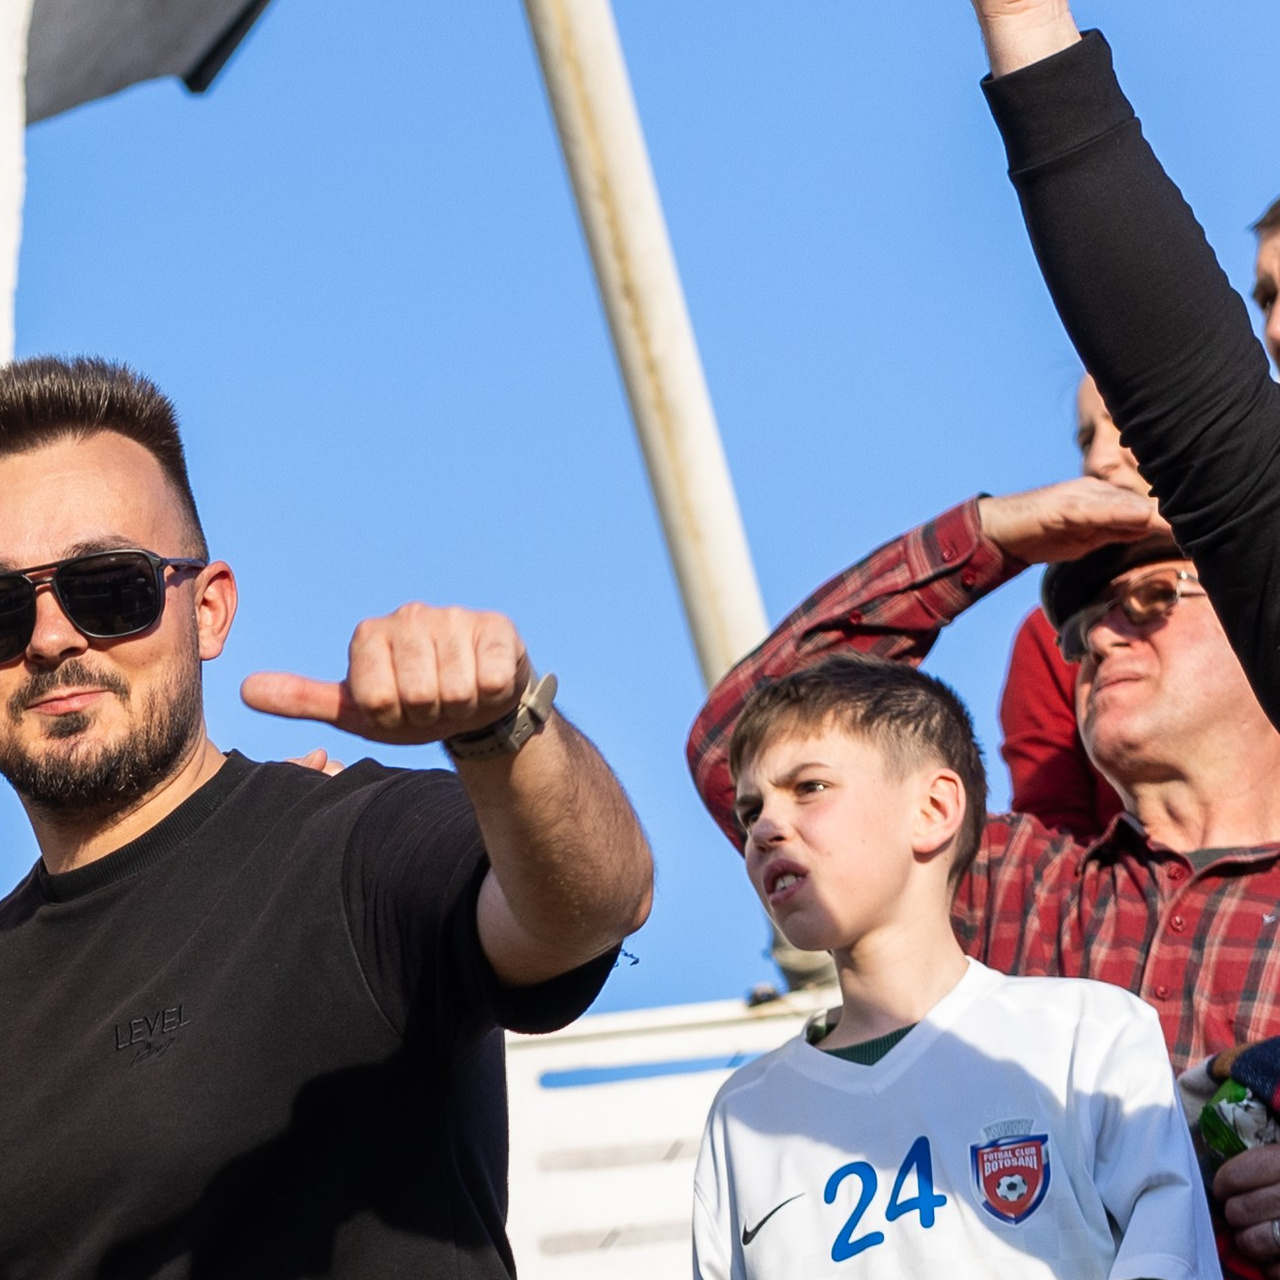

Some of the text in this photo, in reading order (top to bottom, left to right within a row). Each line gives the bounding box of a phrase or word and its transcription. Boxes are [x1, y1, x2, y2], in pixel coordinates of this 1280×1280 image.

[114, 1004, 191, 1052] LEVEL
[983, 1145, 1037, 1161] FOTBAL CLUB
[824, 1135, 948, 1263] 24
